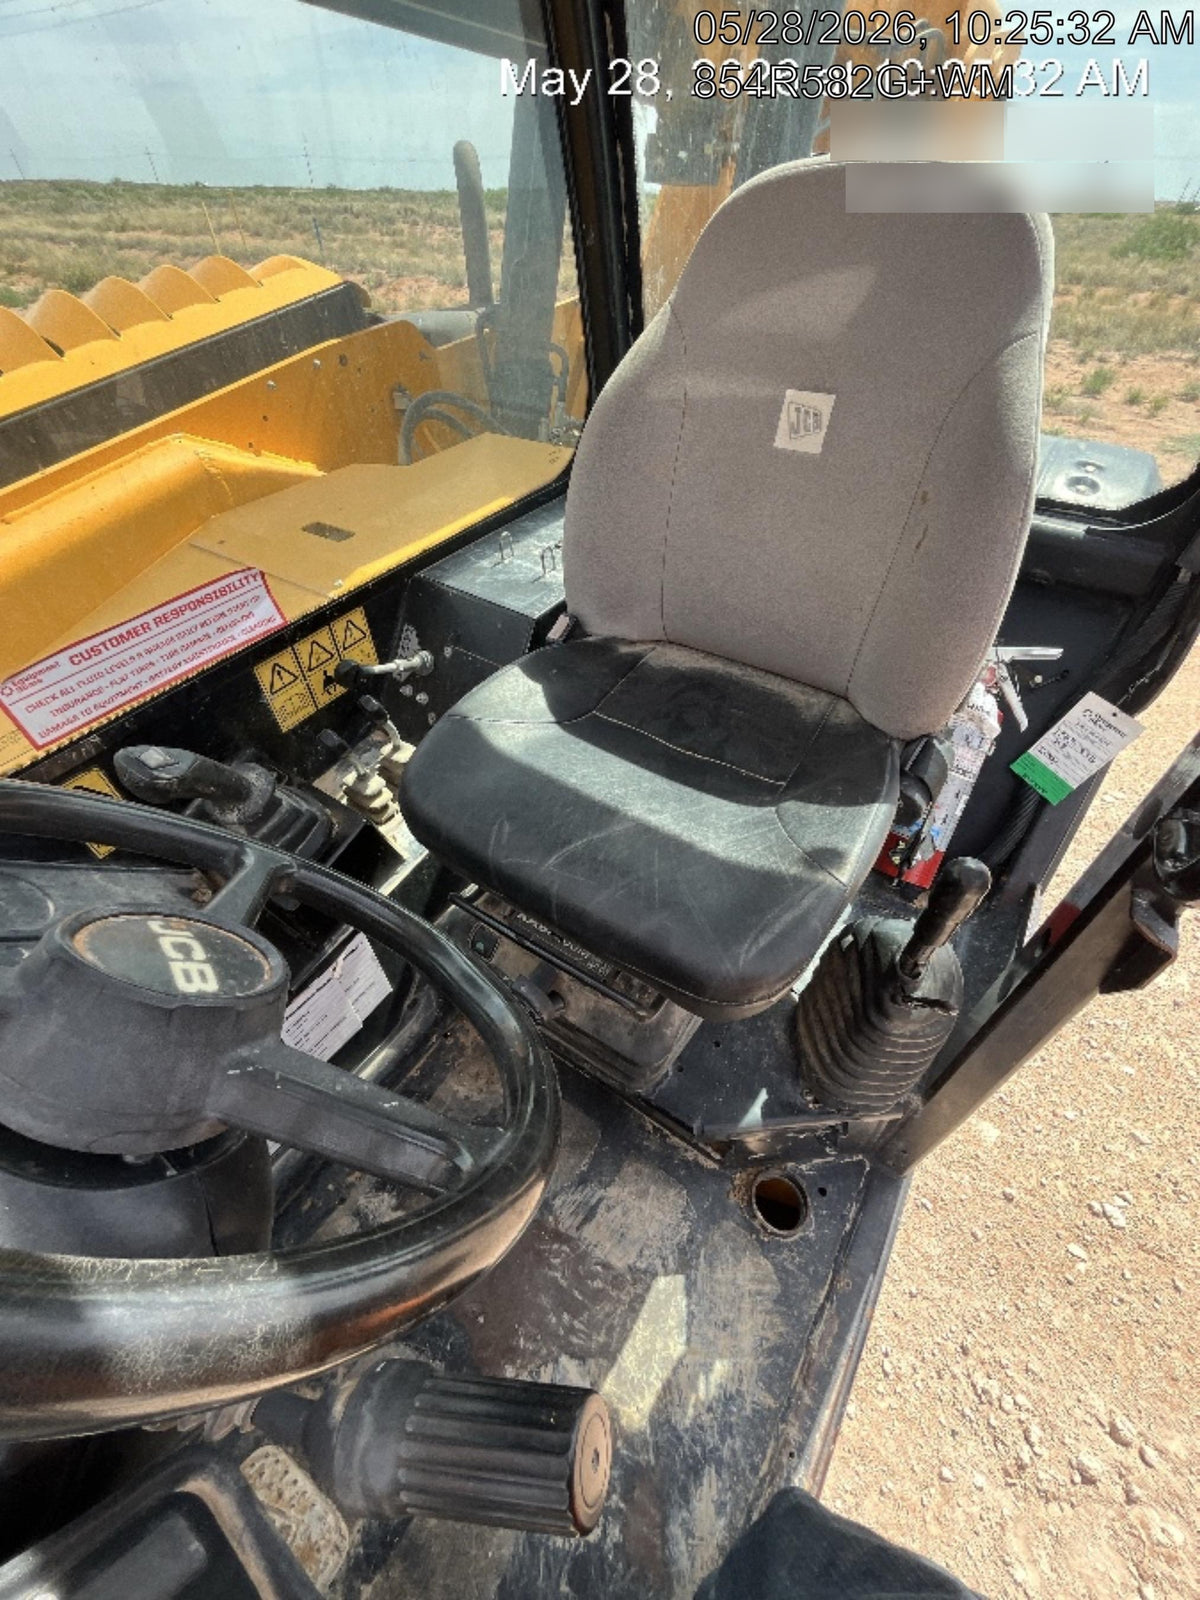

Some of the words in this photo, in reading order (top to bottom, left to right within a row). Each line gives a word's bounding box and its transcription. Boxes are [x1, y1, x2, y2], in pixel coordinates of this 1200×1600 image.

[69, 621, 152, 666] CUSTOMER
[152, 573, 259, 628] RESPONSIBILITY
[25, 692, 60, 714] CHECK
[147, 920, 219, 993] JCB
